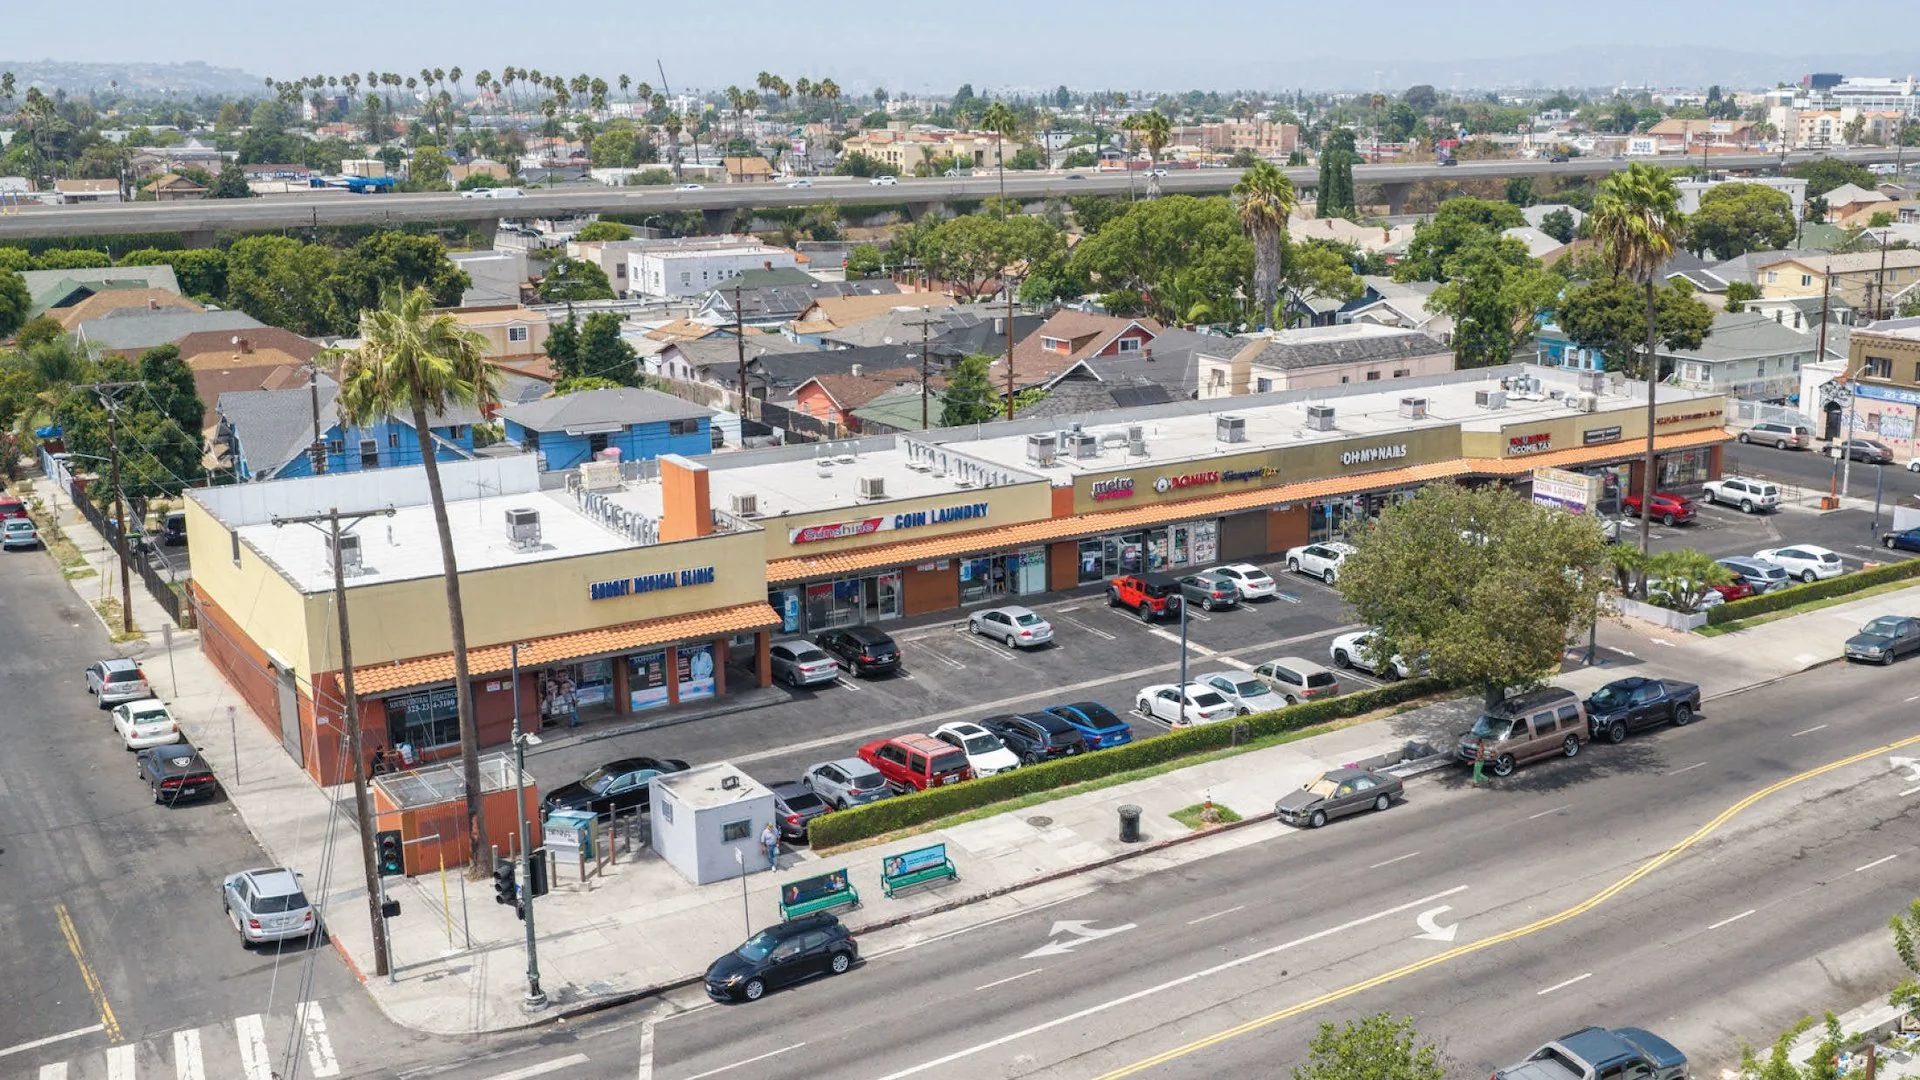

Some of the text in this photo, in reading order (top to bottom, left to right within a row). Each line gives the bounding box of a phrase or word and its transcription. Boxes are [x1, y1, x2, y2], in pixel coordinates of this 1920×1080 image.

[1378, 445, 1407, 460] NAILS
[1092, 476, 1134, 493] metro
[1171, 471, 1219, 488] DONUTS
[803, 503, 988, 541] Sunshine COIN LAUNDRY
[633, 571, 677, 594] MEDICAL
[681, 566, 715, 586] CLINIC
